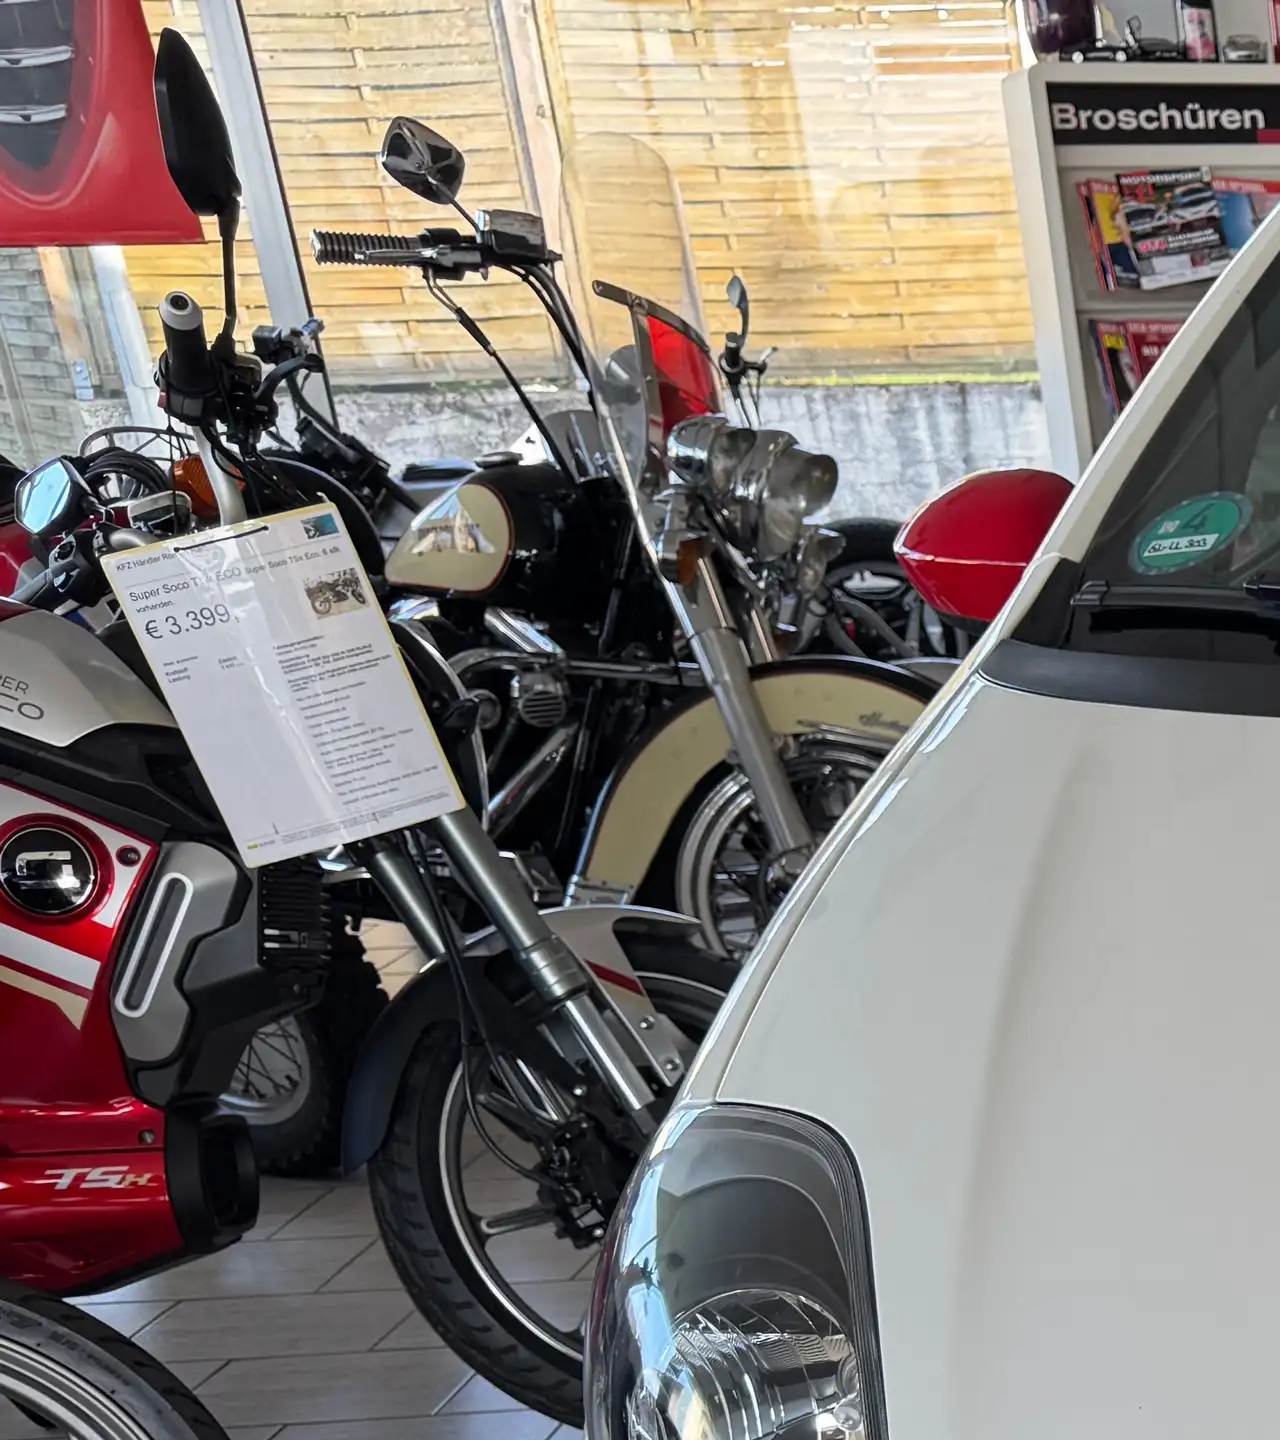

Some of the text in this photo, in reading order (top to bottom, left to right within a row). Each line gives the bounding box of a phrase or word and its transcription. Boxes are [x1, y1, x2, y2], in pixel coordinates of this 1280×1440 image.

[1051, 102, 1265, 130] Broschüren
[1182, 503, 1216, 529] 4
[116, 563, 133, 572] KFZ
[130, 587, 160, 602] Super
[162, 581, 190, 594] Soco
[215, 567, 241, 581] ECO
[145, 619, 164, 639] €
